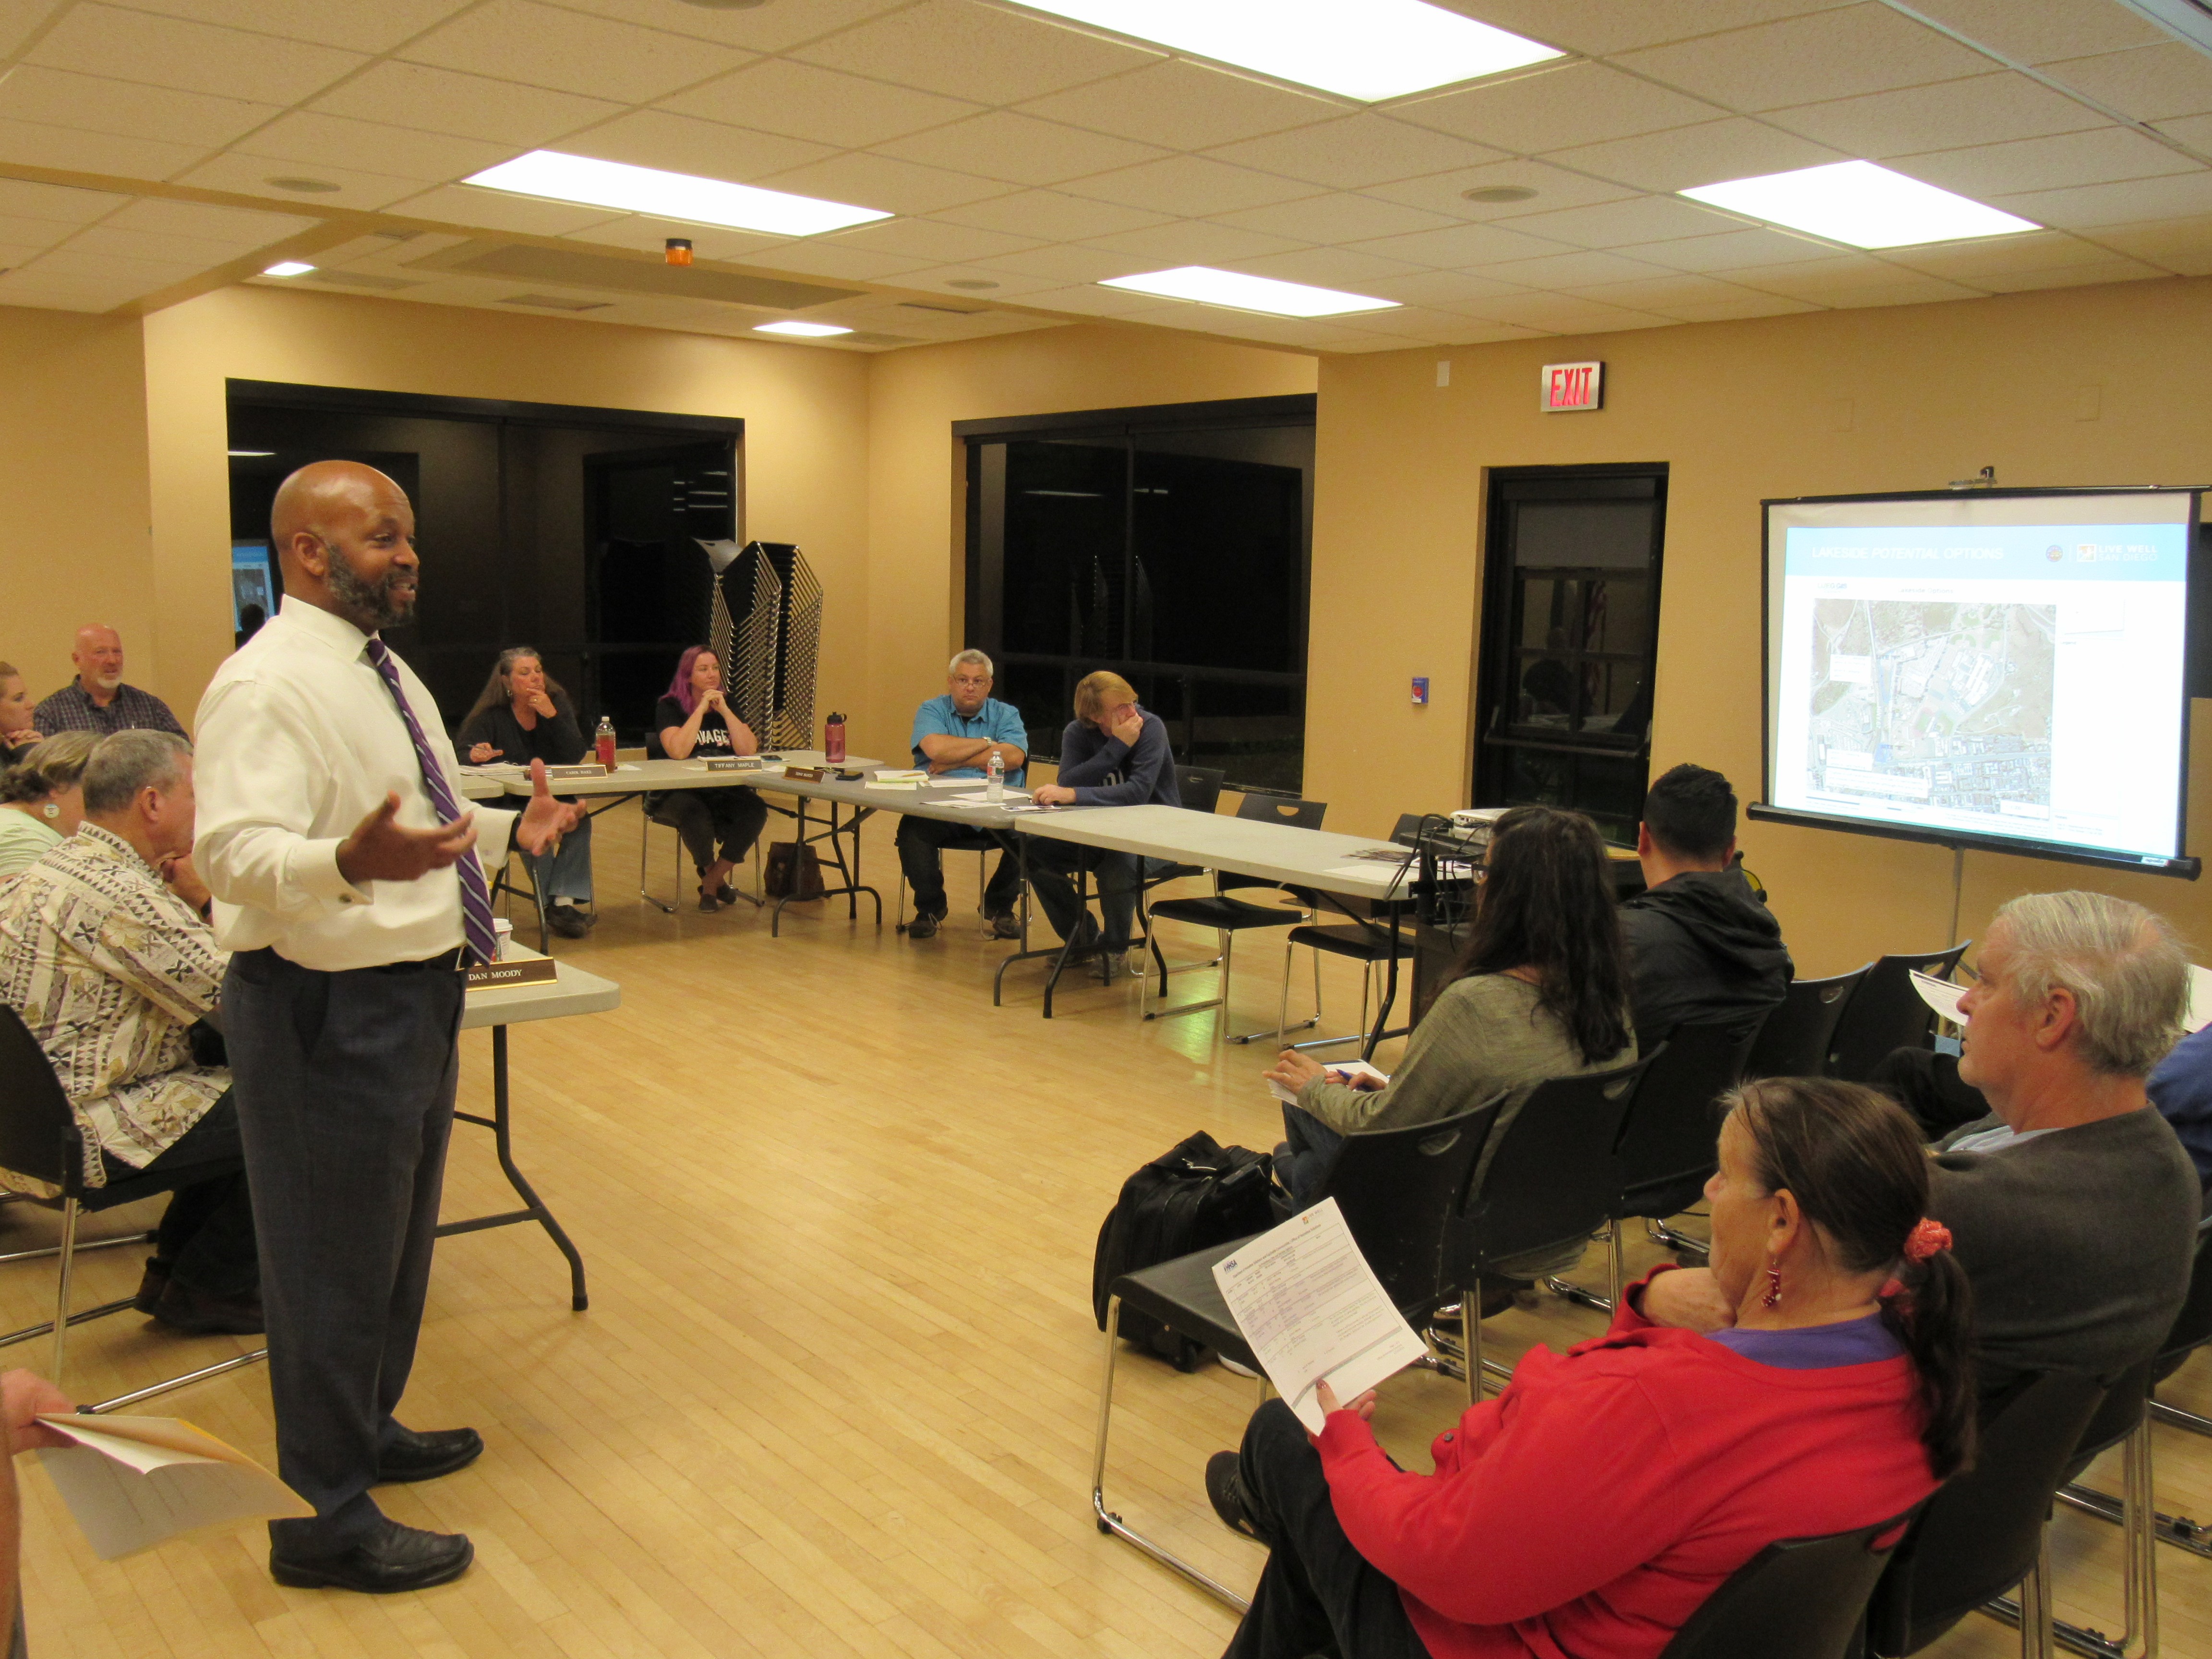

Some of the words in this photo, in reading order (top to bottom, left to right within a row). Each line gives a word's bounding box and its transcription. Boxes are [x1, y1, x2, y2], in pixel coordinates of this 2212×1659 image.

[1551, 367, 1592, 407] EXIT
[1812, 547, 1869, 559] LAKESIDE
[1870, 547, 1940, 559] POTENTIAL
[1943, 548, 2004, 559] OPTIONS
[2098, 544, 2122, 553] LIVE
[2127, 544, 2158, 553] WELL
[695, 729, 730, 745] AVAGE
[469, 972, 488, 981] DAN
[492, 969, 522, 979] MOODY
